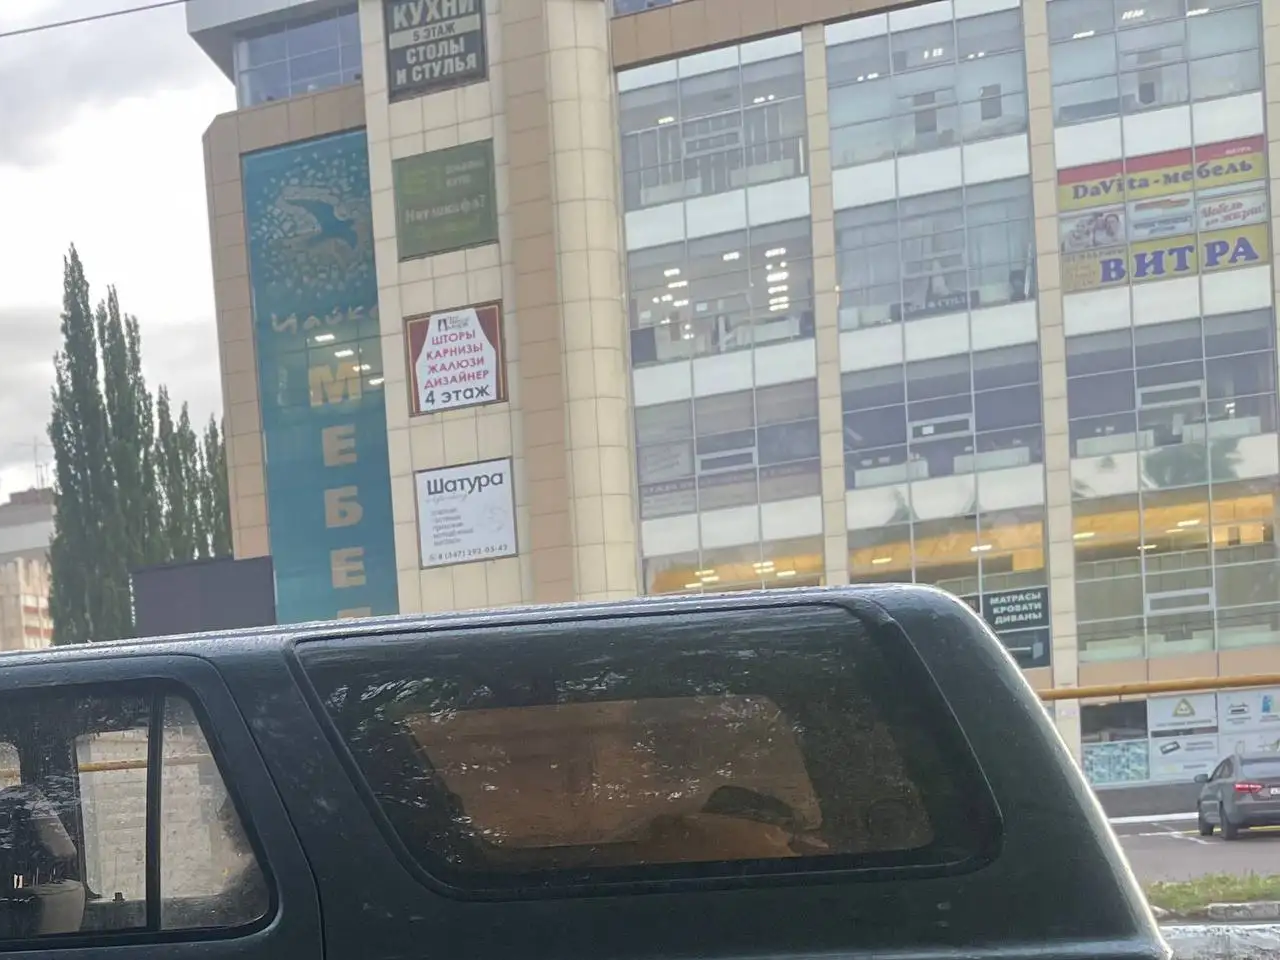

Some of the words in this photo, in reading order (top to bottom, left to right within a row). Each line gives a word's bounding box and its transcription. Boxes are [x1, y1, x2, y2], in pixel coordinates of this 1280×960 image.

[412, 28, 420, 42] 5
[422, 21, 456, 39] ЭТАЖ
[406, 36, 465, 65] СТОЛЫ
[412, 52, 477, 82] СТУЛЬЯ
[1100, 236, 1260, 284] ВИТРА
[431, 329, 476, 346] ШТОРЫ
[426, 342, 483, 361] КАРНИЗЫ
[427, 355, 485, 375] ЖАЛЮЗИ
[423, 369, 489, 390] ДИЗАЙНЕР
[424, 390, 436, 406] 4
[440, 384, 491, 403] этаж
[307, 359, 372, 619] МЕБЕ
[427, 472, 504, 496] Шатура
[989, 591, 1042, 606] МАТРАСЫ
[992, 602, 1043, 615] КРОВАТИ
[994, 611, 1043, 625] ДИВАНЫ
